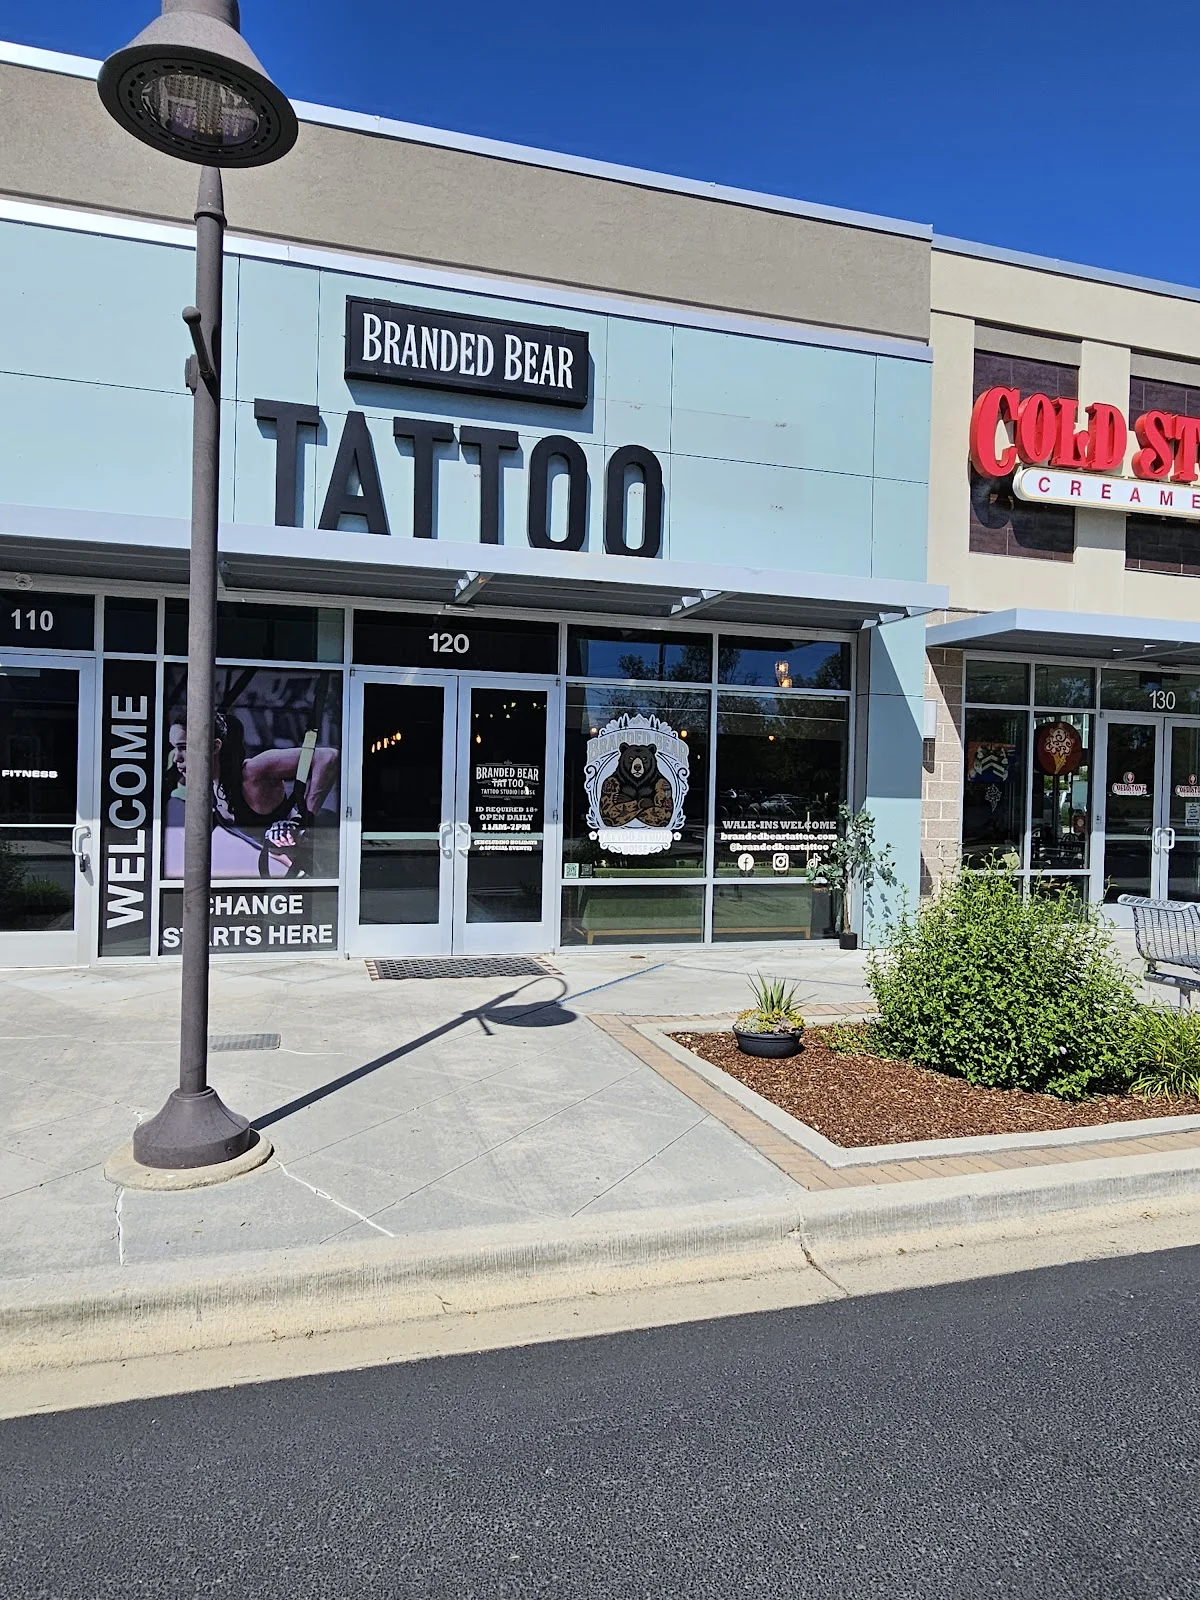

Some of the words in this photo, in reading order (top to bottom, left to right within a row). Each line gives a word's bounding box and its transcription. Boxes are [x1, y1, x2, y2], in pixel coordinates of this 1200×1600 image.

[362, 312, 494, 377] BRANDED
[504, 334, 575, 389] BEAR
[970, 386, 1127, 478] COLD
[254, 398, 663, 558] TATTOO
[1038, 477, 1200, 509] CREAME
[11, 609, 53, 631] 110
[428, 633, 470, 654] 120
[1149, 690, 1176, 710] 130
[588, 731, 651, 763] BRANDED
[654, 733, 688, 766] BEAR
[2, 770, 58, 779] FITNESS
[476, 766, 515, 780] BRANDED
[517, 768, 539, 782] BEAR
[491, 778, 524, 788] TATTOO
[106, 695, 148, 929] WELCOME
[482, 823, 531, 831] 11AM-7PM
[722, 820, 779, 830] WALK-INS
[780, 820, 837, 830] WELCOME
[720, 832, 838, 841] brandedbeartattoo.com
[729, 843, 830, 853] @brandedbeartattoo
[162, 925, 262, 948] SRTS
[268, 924, 333, 945] HERE
